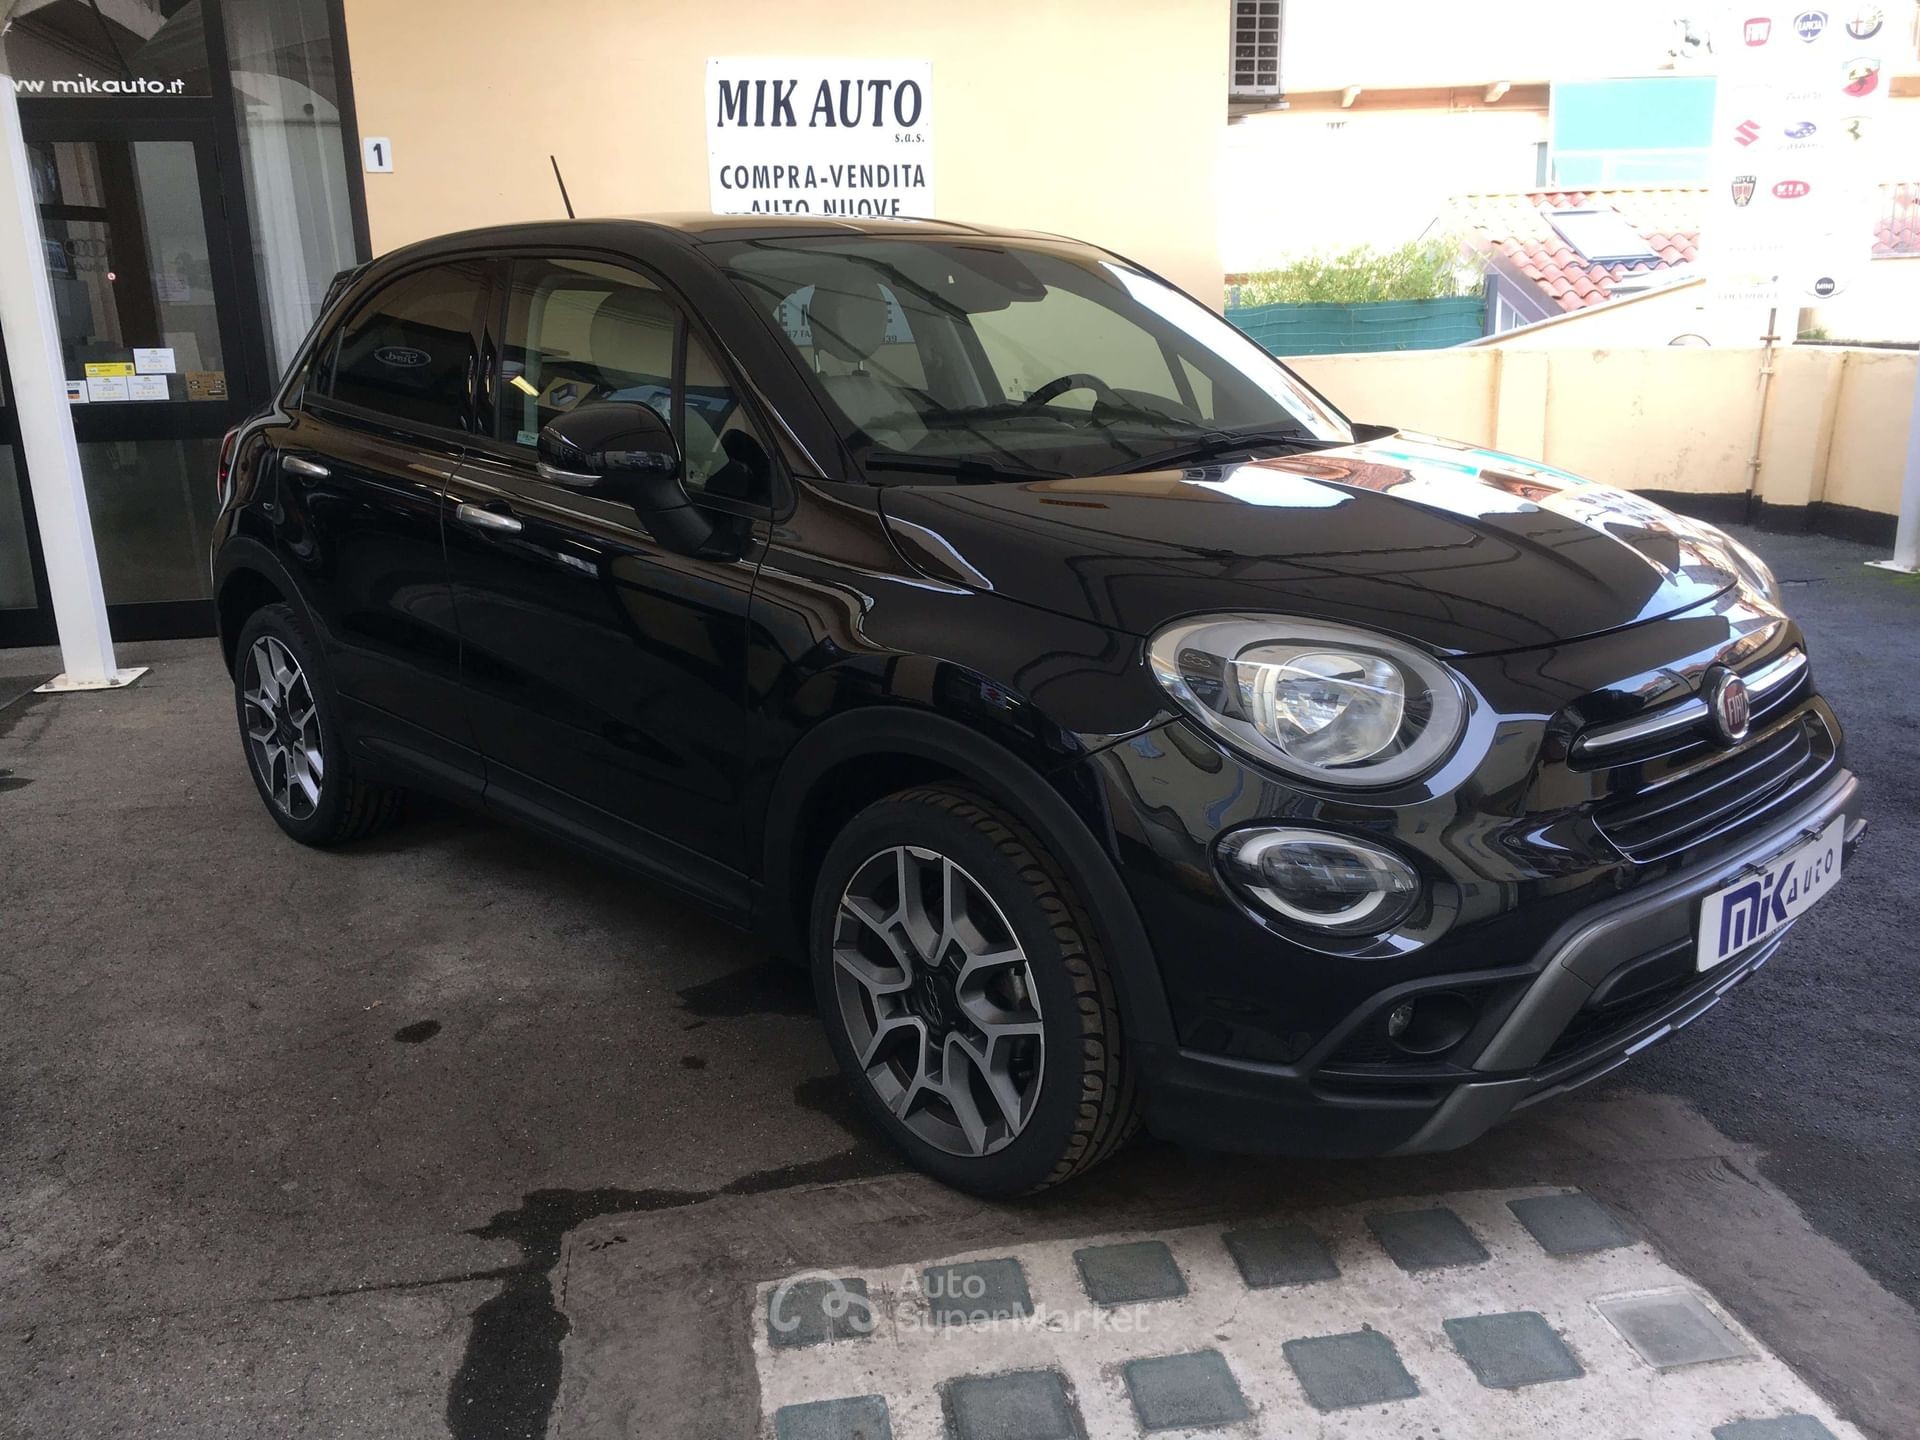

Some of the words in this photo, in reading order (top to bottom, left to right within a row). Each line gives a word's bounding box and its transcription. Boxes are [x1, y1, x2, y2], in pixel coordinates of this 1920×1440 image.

[717, 79, 798, 127] MIK
[808, 79, 922, 128] AUTO
[894, 131, 925, 143] s.a.s.
[371, 143, 384, 167] 1
[720, 164, 926, 189] COMPRA-VENDITA
[823, 198, 901, 216] NUOVE
[1727, 691, 1747, 725] FIAT
